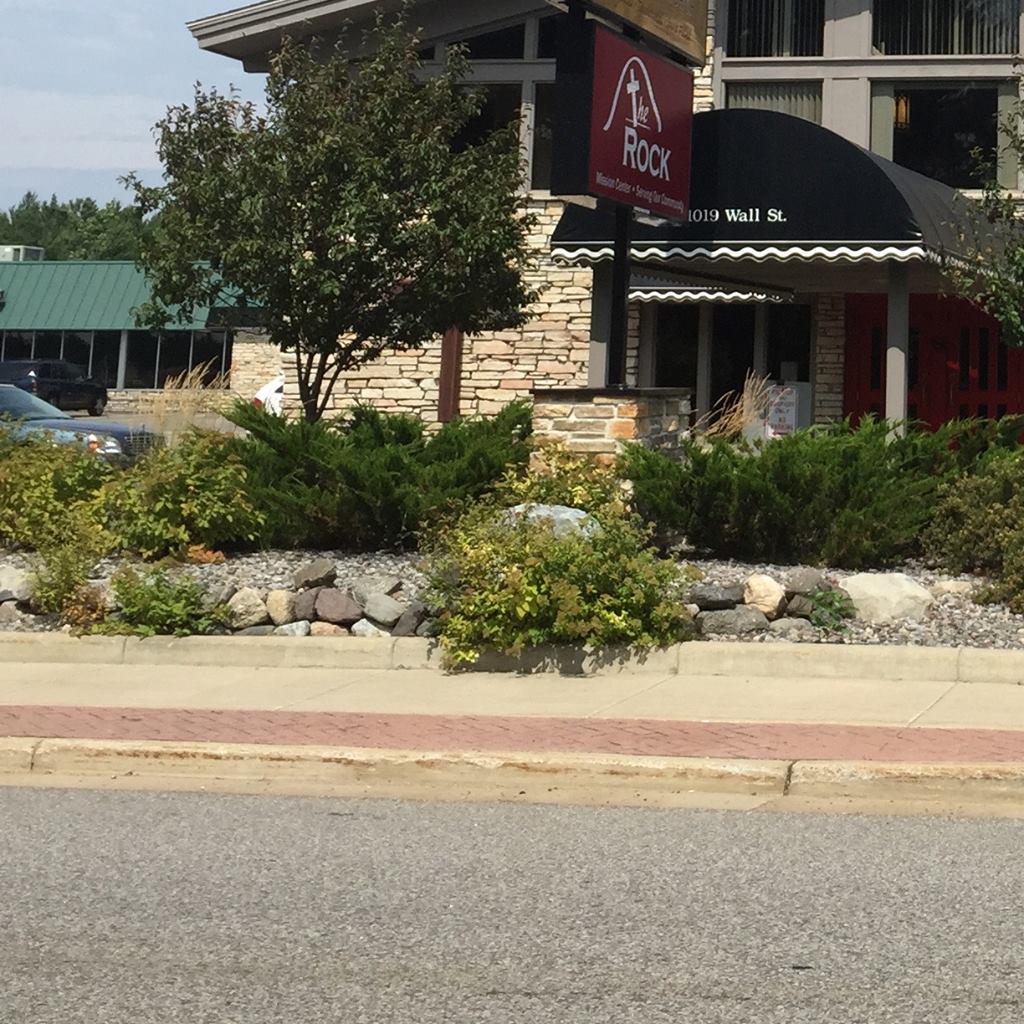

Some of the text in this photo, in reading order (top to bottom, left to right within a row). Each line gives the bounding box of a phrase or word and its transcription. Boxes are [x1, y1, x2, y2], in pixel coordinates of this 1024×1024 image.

[623, 126, 671, 182] ROCK
[688, 208, 787, 222] 1019 Wall St.
